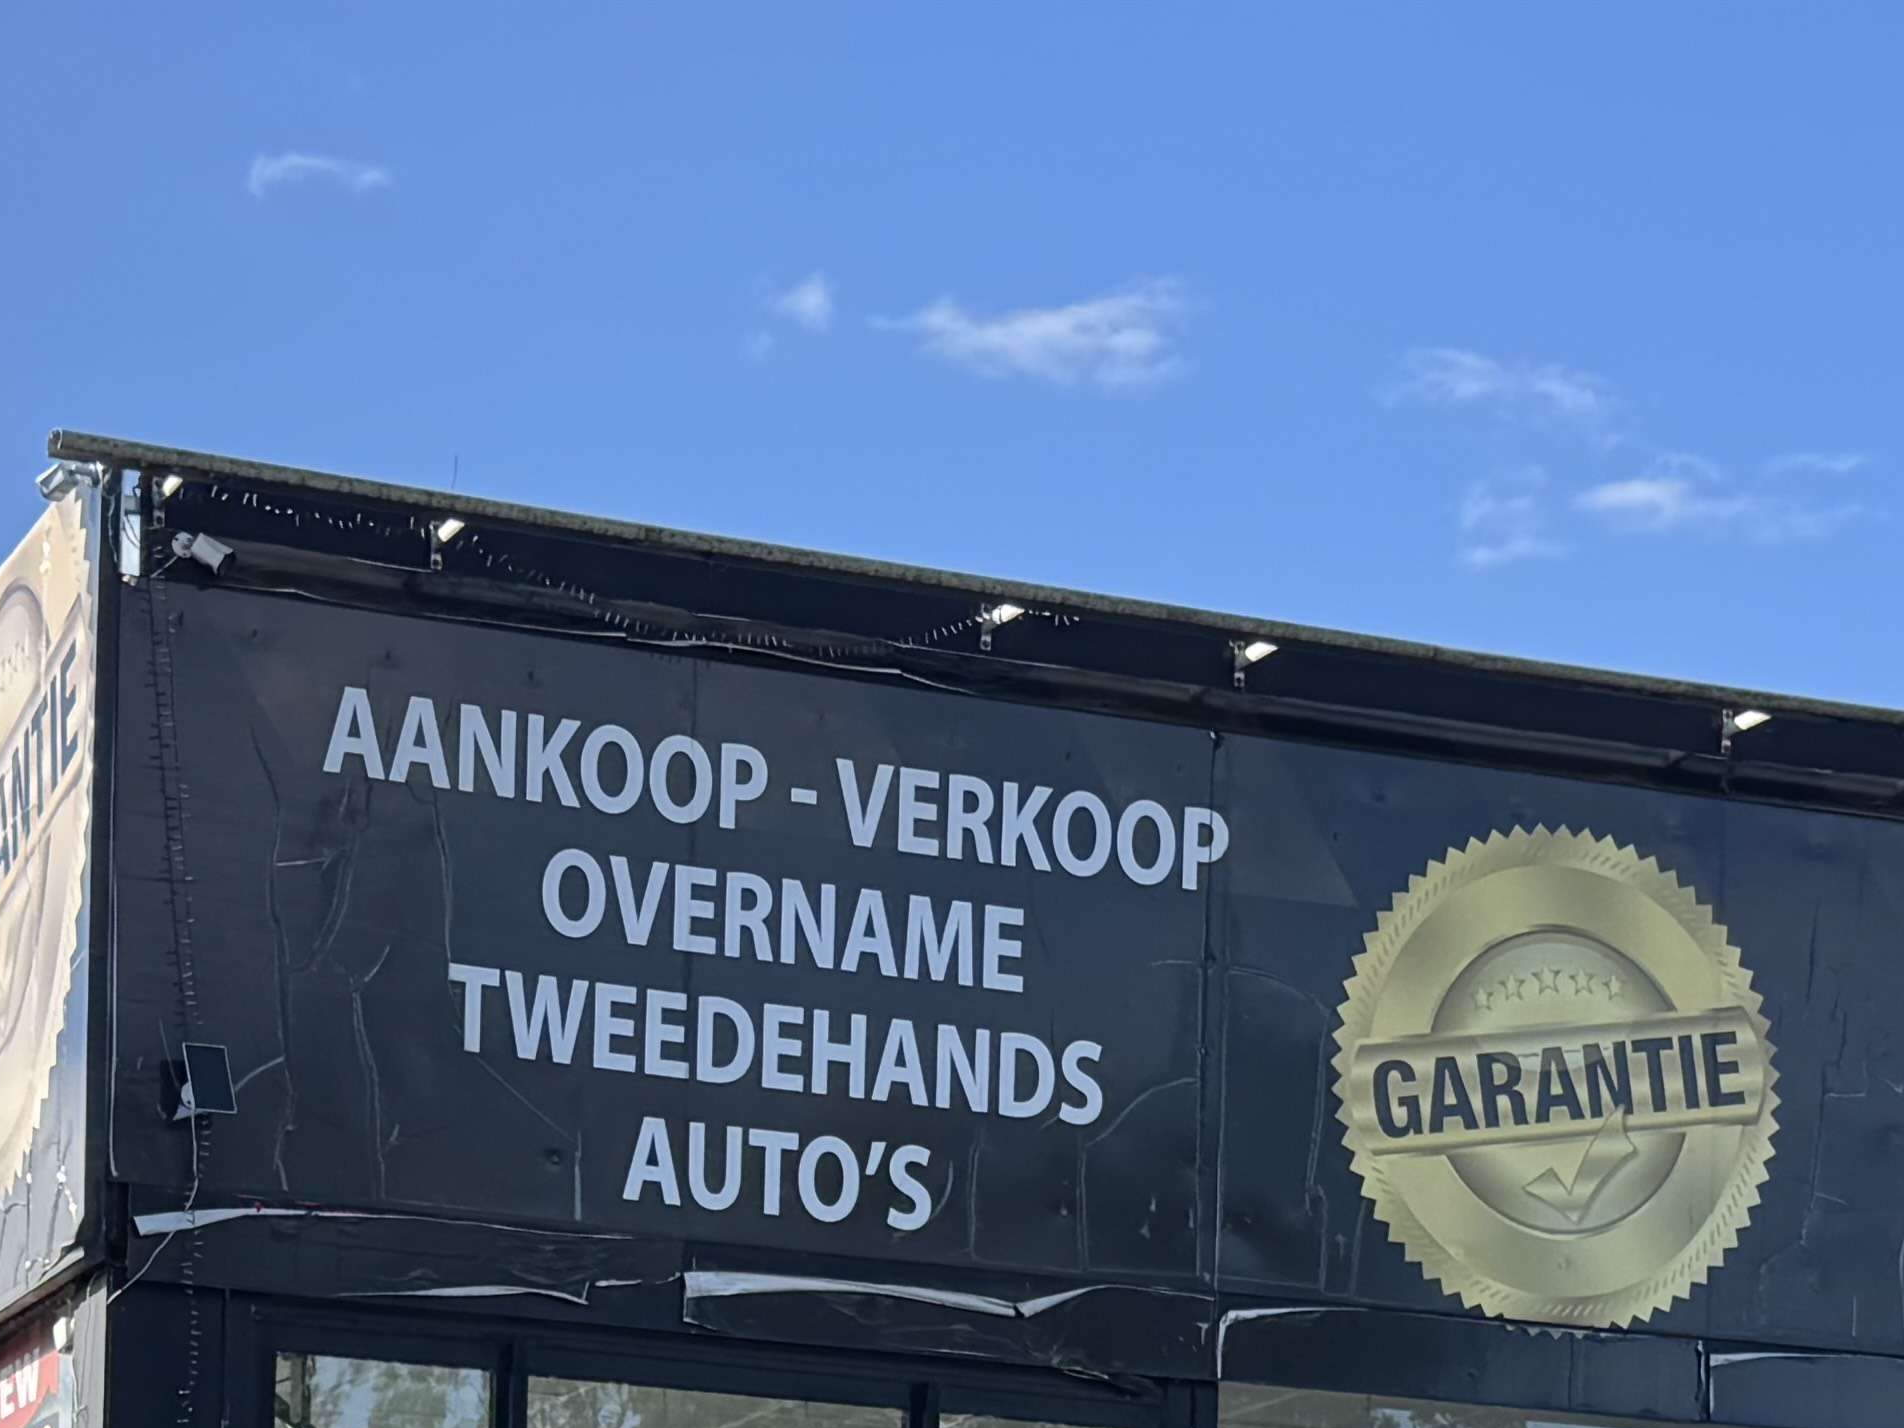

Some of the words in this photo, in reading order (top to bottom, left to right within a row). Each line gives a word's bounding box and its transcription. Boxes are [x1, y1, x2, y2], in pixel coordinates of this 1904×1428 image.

[323, 686, 769, 830] AANKOOP
[836, 757, 1230, 891] VERKOOP
[541, 847, 1025, 993] OVERNAME
[448, 962, 1104, 1126] TWEEDEHANDS
[1371, 1030, 1747, 1140] GARANTIE
[622, 1115, 933, 1232] AUTO'S
